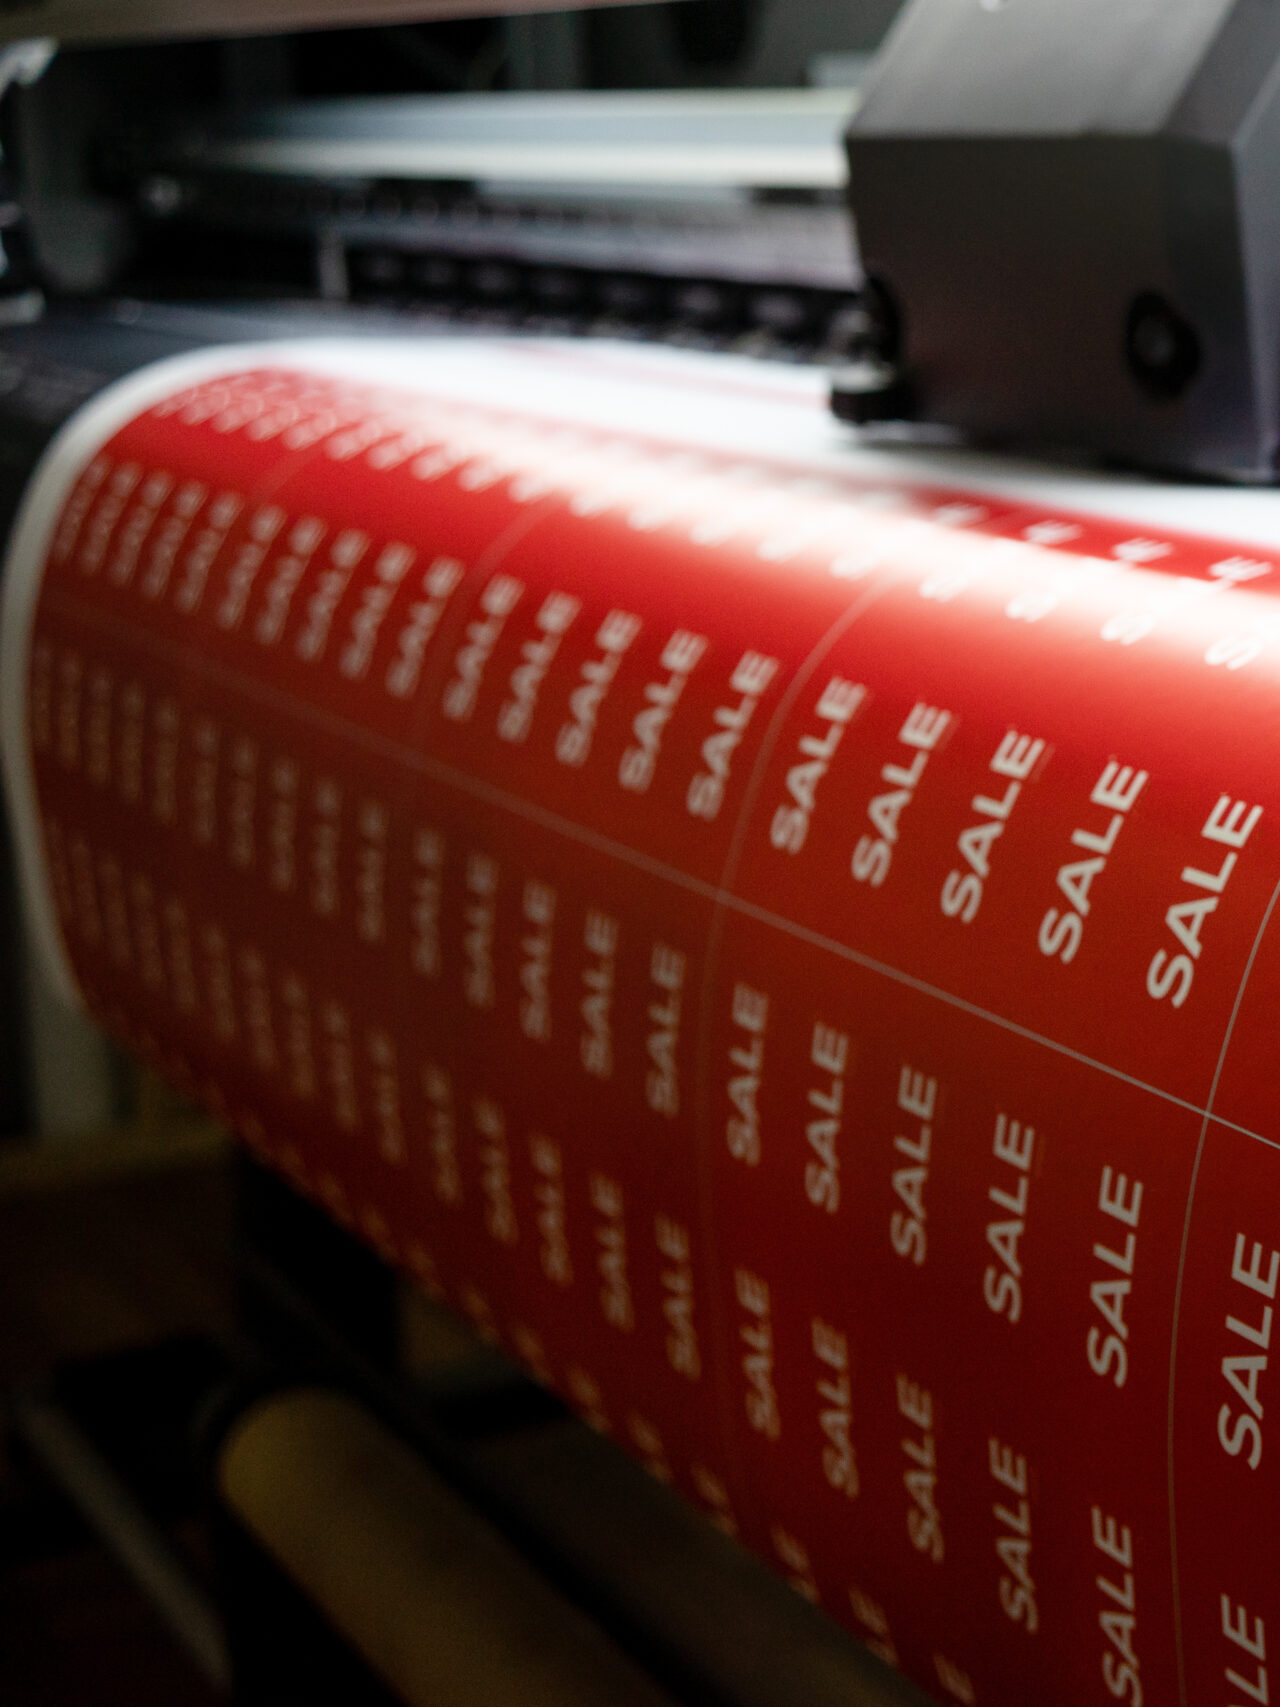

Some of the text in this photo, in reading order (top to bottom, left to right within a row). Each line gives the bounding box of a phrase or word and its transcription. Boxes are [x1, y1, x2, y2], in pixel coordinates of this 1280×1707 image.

[498, 590, 582, 743] SALE
[556, 607, 642, 766] SALE
[619, 629, 708, 792] SALE
[687, 649, 779, 819] SALE
[770, 675, 868, 853] SALE
[851, 701, 952, 888] SALE
[940, 730, 1046, 923] SALE
[1038, 760, 1148, 964] SALE
[1147, 794, 1263, 1008] SALE
[646, 942, 685, 1114] SALE
[727, 981, 768, 1167] SALE
[806, 1022, 849, 1214] SALE
[891, 1066, 937, 1266] SALE
[985, 1113, 1035, 1323] SALE
[1087, 1165, 1143, 1387] SALE
[1218, 1233, 1280, 1470] SALE
[811, 1315, 858, 1498] SALE
[896, 1374, 943, 1563] SALE
[989, 1437, 1037, 1634] SALE
[1091, 1507, 1142, 1707] SALE
[1220, 1593, 1268, 1707] LE
